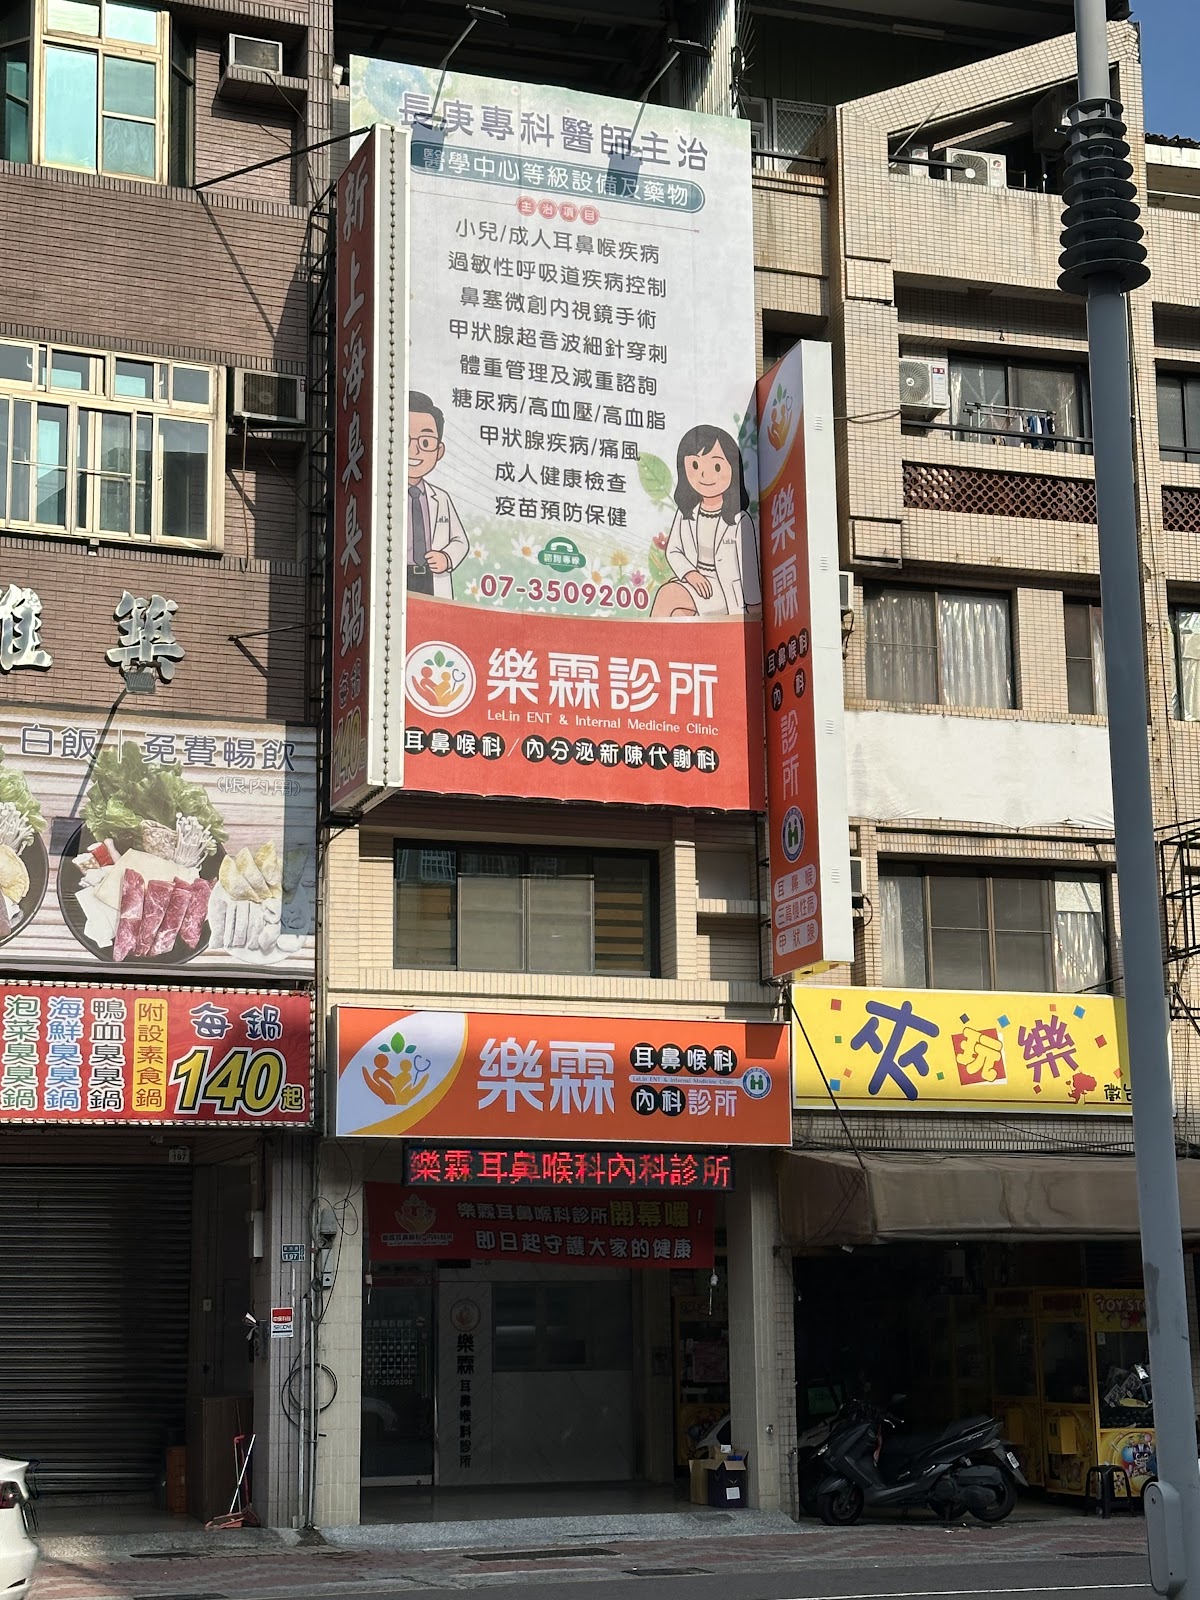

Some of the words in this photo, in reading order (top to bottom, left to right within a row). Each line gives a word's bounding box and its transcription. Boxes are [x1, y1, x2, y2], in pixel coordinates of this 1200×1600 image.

[399, 92, 708, 171] 長庚專科醫師主治
[423, 147, 689, 206] 醫學中心等級設備及藥物
[520, 200, 596, 221] 主治項目
[455, 218, 660, 264] 小兒/成人耳鼻喉疾病
[448, 250, 667, 298] 過敏性呼吸道疾病控制
[460, 286, 657, 330] 鼻塞微創內視鏡手術
[449, 319, 668, 364] 甲狀腺超音波細針穿刺
[460, 354, 658, 396] 體重管理及減重諮詢
[339, 155, 369, 658] 新上海臭臭鍋
[452, 387, 667, 430] 糖尿病/高血壓/高血脂
[480, 425, 641, 462] 甲狀腺疾病/痛風
[495, 462, 627, 494] 成人健康檢查
[495, 496, 628, 528] 疫苗預防保健
[771, 482, 799, 628] 樂霖
[480, 574, 649, 610] 07-3509200
[766, 630, 808, 676] 耳鼻喉科
[486, 647, 719, 719] 樂霖診所
[488, 709, 520, 723] LeLin
[527, 712, 552, 724] ENT
[559, 714, 568, 725] &
[575, 715, 621, 729] Internal
[627, 718, 680, 733] Medicine
[687, 723, 719, 736] Clinic
[21, 725, 98, 760] 白飯
[143, 733, 296, 772] 免費暢飲
[781, 710, 799, 800] 診所
[189, 1002, 282, 1039] 每鍋
[2, 996, 40, 1110] 泡菜臭臭鍋
[46, 997, 83, 1110] 海鮮臭臭鍋
[90, 998, 126, 1110] 鴨血臭臭鍋
[136, 1003, 164, 1109] 附設素食鍋
[633, 1045, 735, 1074] 耳鼻喉科
[850, 1000, 1079, 1101] 夾玩樂
[477, 1036, 616, 1115] 樂霖
[635, 1088, 738, 1117] 內科診所
[172, 1153, 187, 1161] 197
[409, 1150, 731, 1187] 樂霖耳鼻喉科內科診所
[476, 1230, 692, 1260] 即日起守護大家的健康
